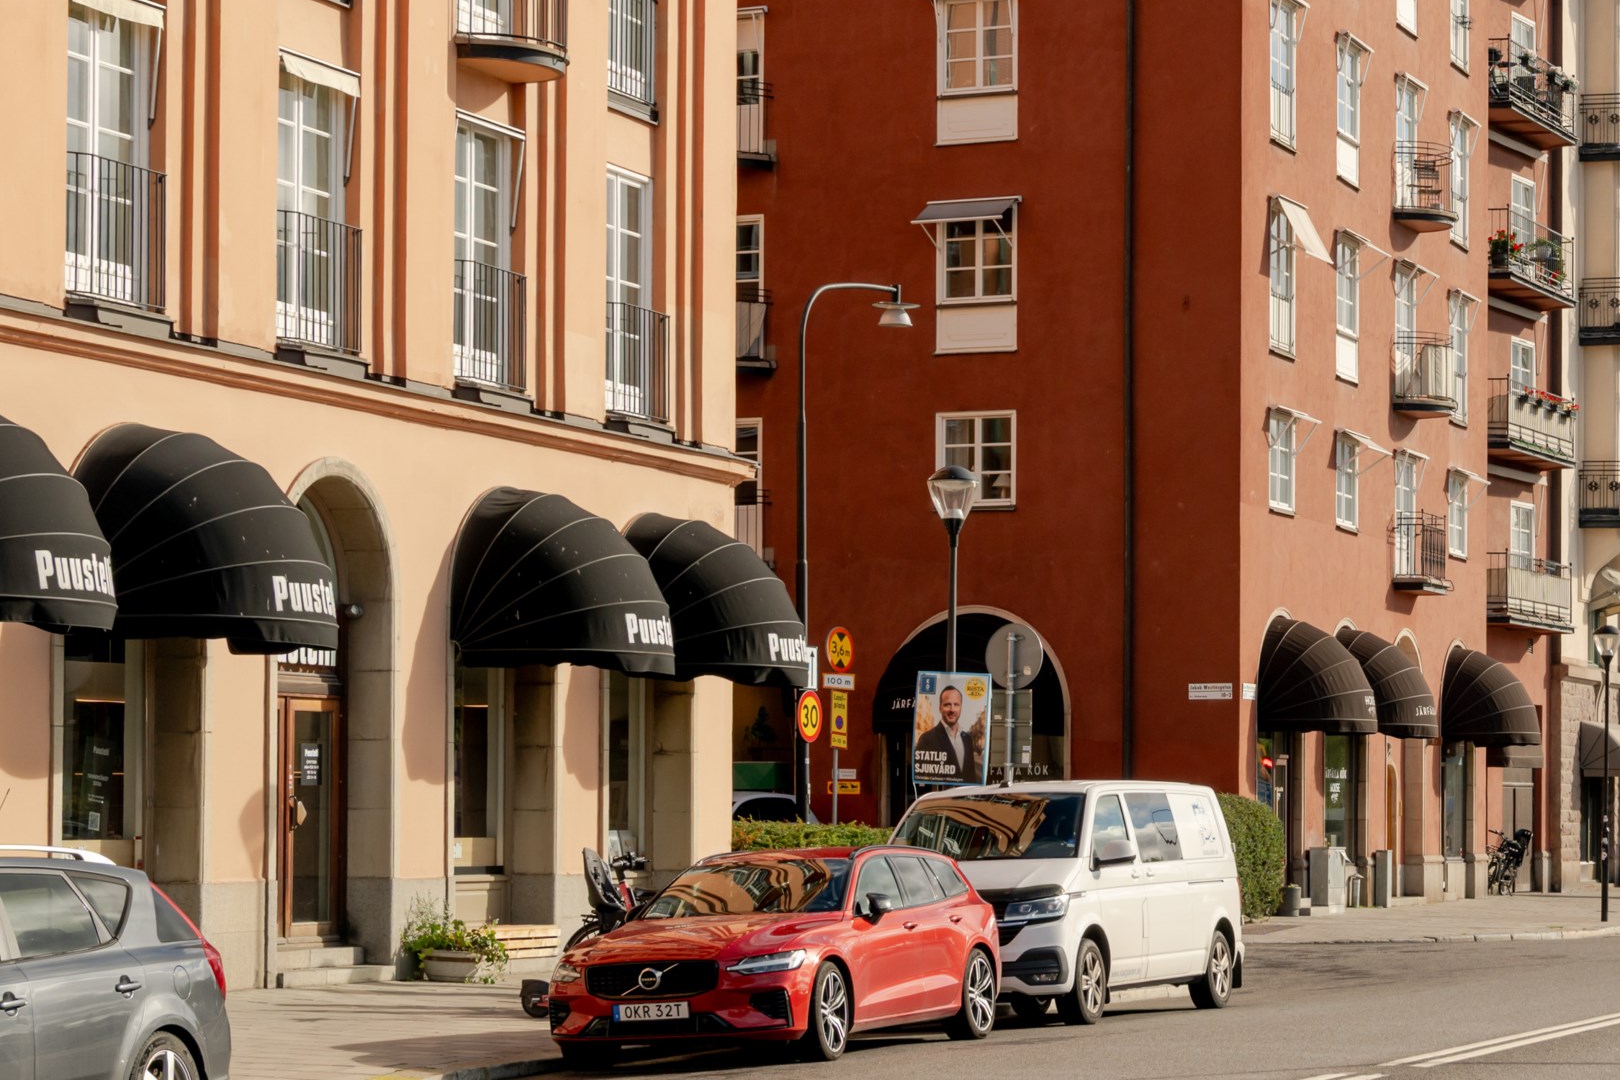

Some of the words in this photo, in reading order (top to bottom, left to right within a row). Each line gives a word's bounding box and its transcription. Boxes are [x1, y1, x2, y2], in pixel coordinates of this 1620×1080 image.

[831, 640, 845, 658] 3,6
[827, 677, 842, 686] 100
[803, 704, 819, 729] 30
[914, 750, 948, 762] STATLIG
[914, 761, 956, 775] SJUKVÅRD
[624, 1005, 651, 1019] OKR
[655, 1003, 682, 1018] 32T
